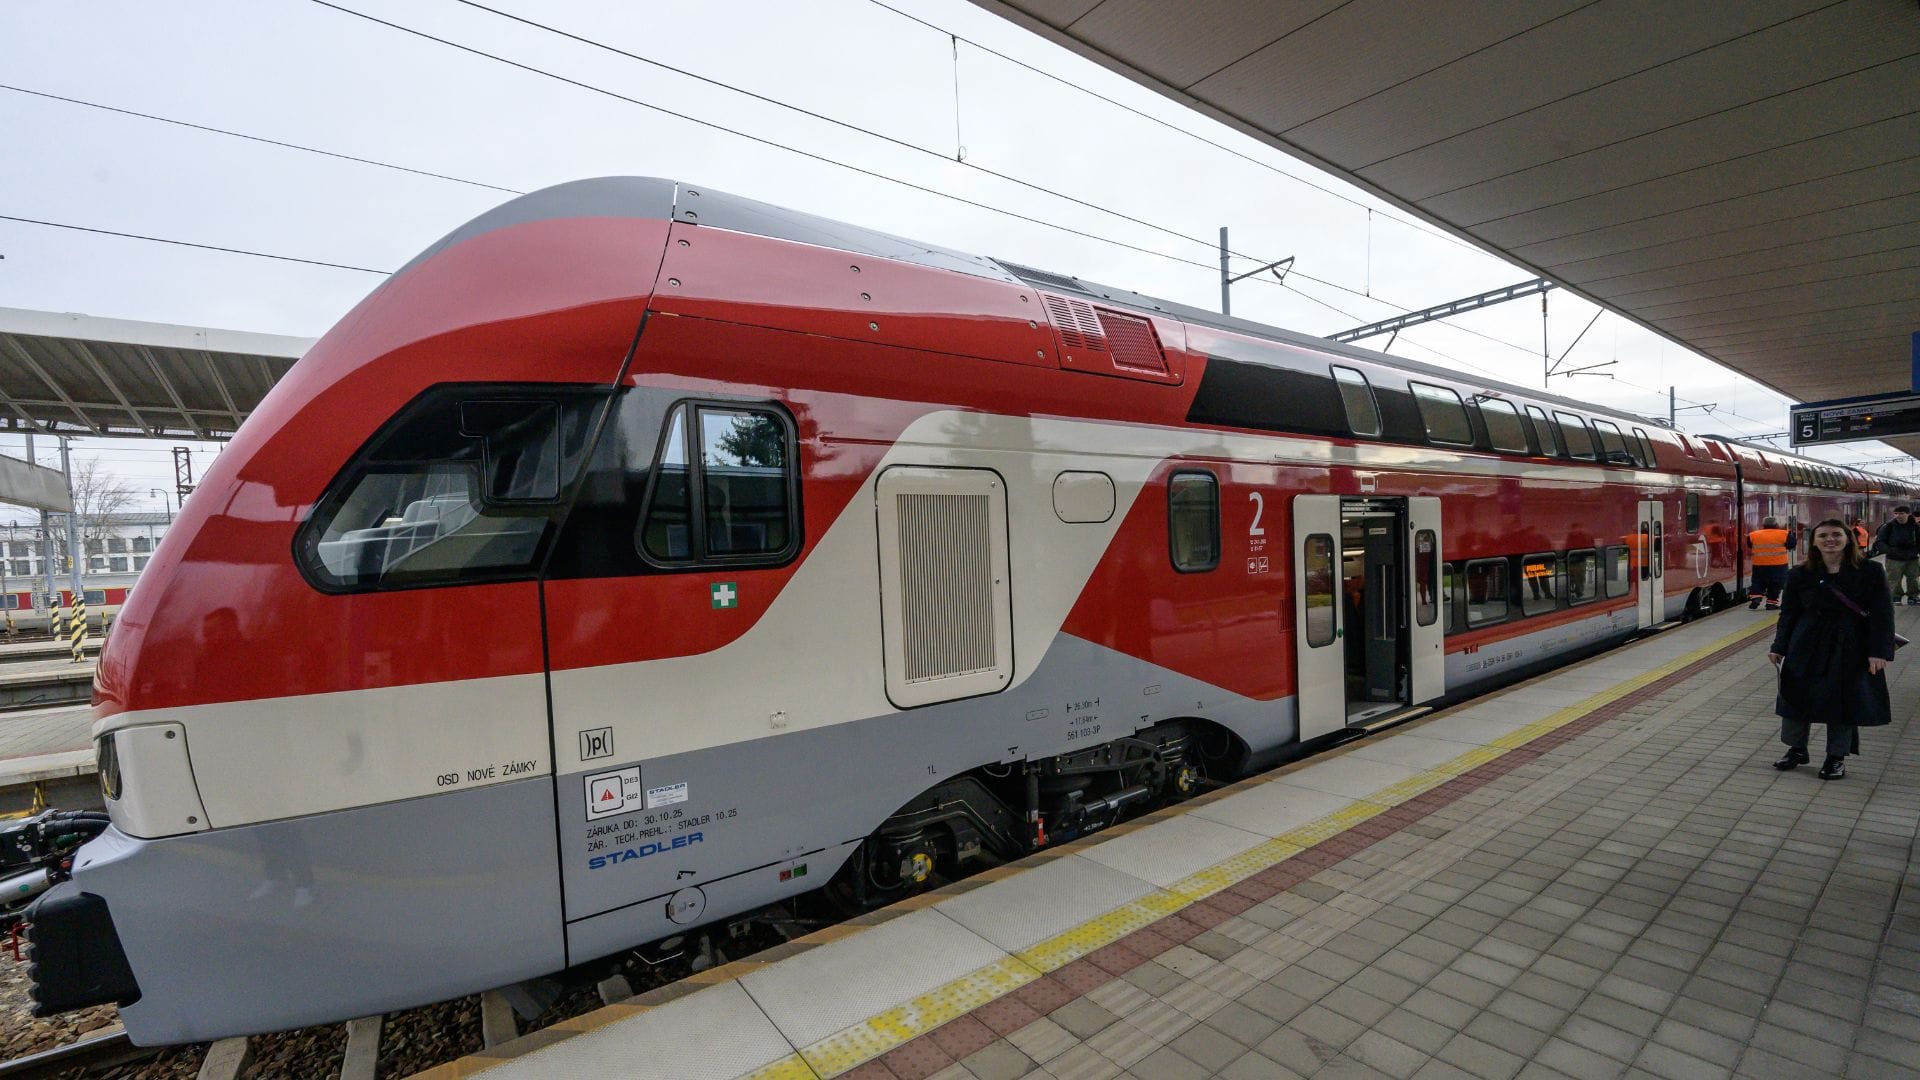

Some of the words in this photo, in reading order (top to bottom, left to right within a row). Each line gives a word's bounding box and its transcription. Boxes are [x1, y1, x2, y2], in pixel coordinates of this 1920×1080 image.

[1802, 424, 1814, 438] 5
[1248, 491, 1265, 536] 2
[437, 773, 459, 786] OSD
[467, 764, 495, 781] NOVÉ
[502, 760, 537, 776] ZÁMKY
[624, 776, 639, 784] DE3
[927, 764, 937, 775] 1L
[649, 783, 686, 795] STADLER
[586, 824, 620, 838] ZÁRUKA
[623, 819, 638, 830] DO:
[644, 808, 683, 825] 30.10.25
[588, 839, 608, 852] ZÁR.
[678, 814, 711, 830] STADLER
[716, 808, 738, 821] 10.25
[588, 832, 704, 870] STADLER
